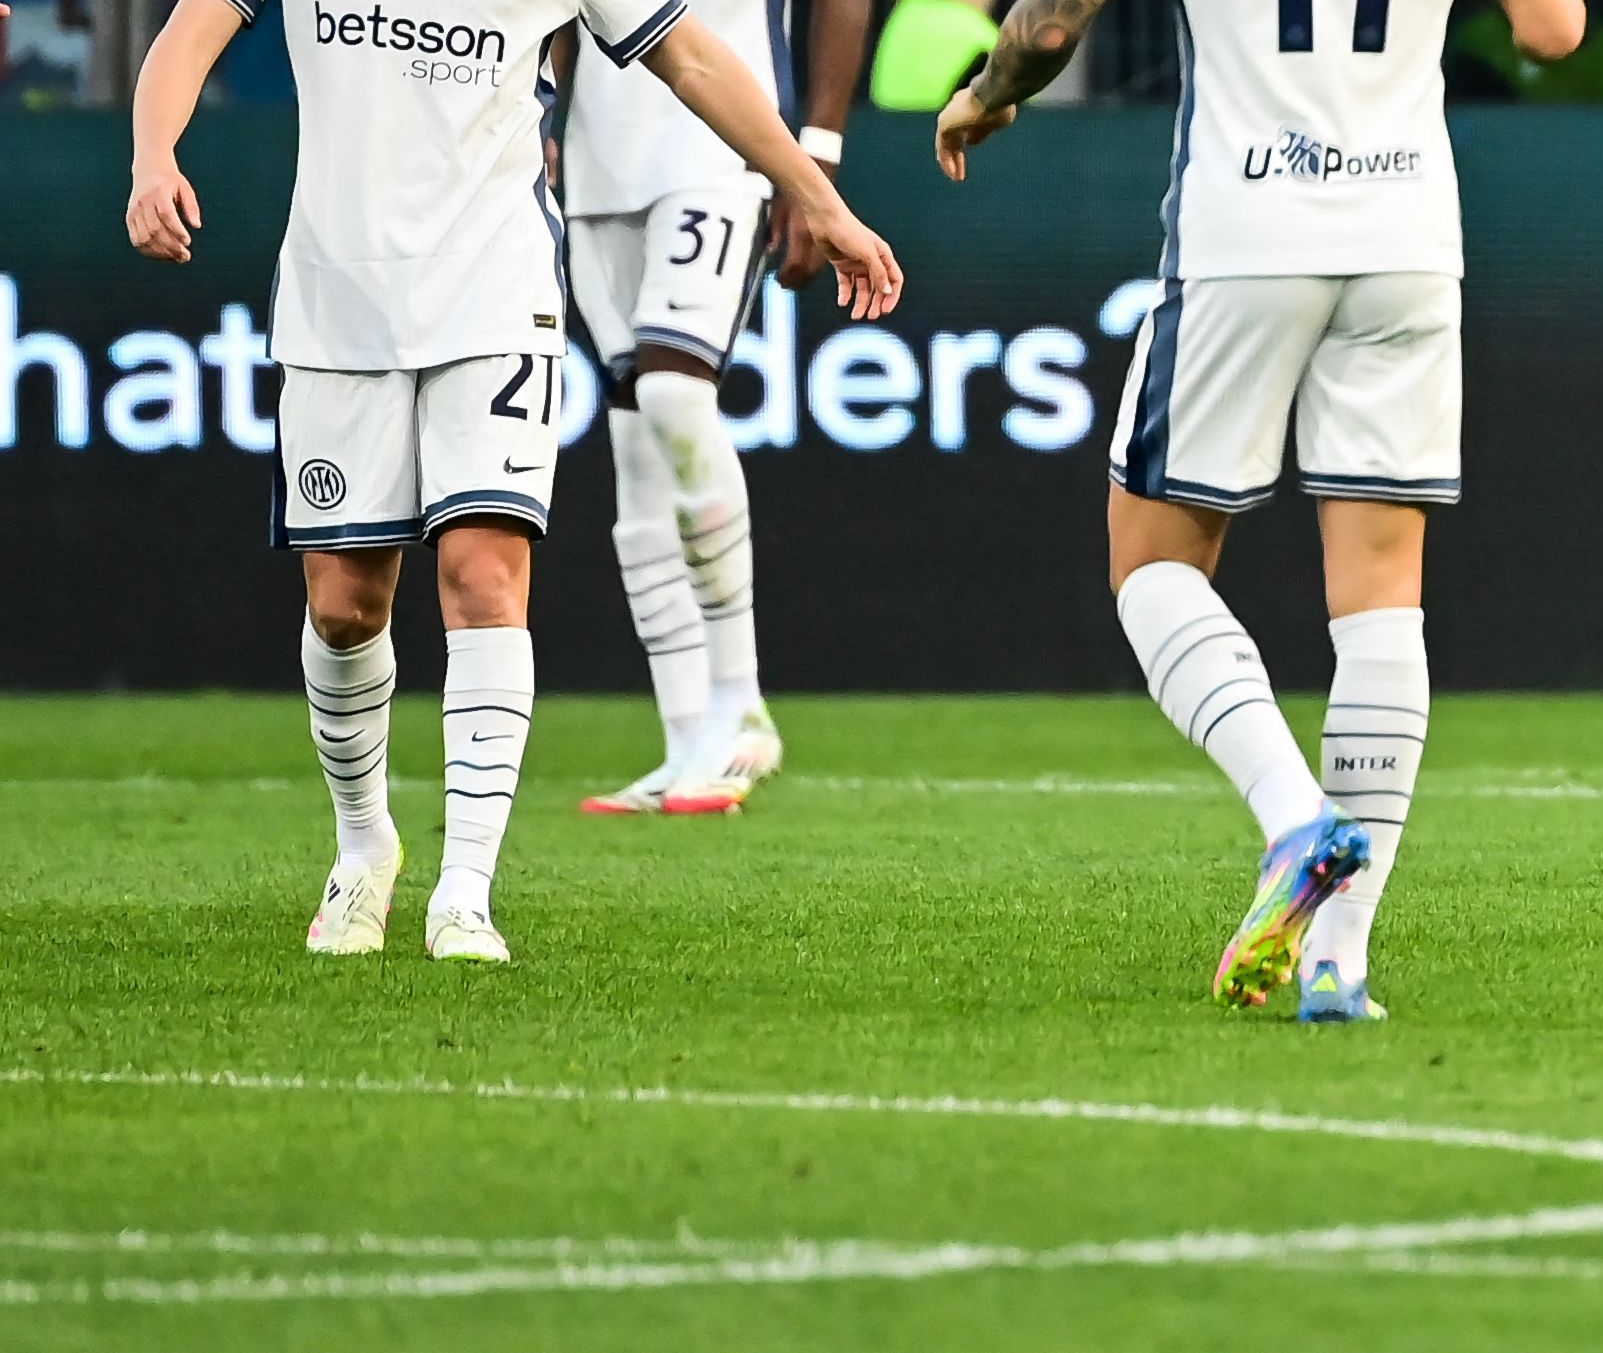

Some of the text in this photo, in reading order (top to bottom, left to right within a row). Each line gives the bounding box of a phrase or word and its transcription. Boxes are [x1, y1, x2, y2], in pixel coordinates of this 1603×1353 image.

[314, 0, 506, 63] betsson
[668, 208, 735, 276] 31
[489, 353, 554, 426] 21
[1334, 756, 1397, 772] INTER
